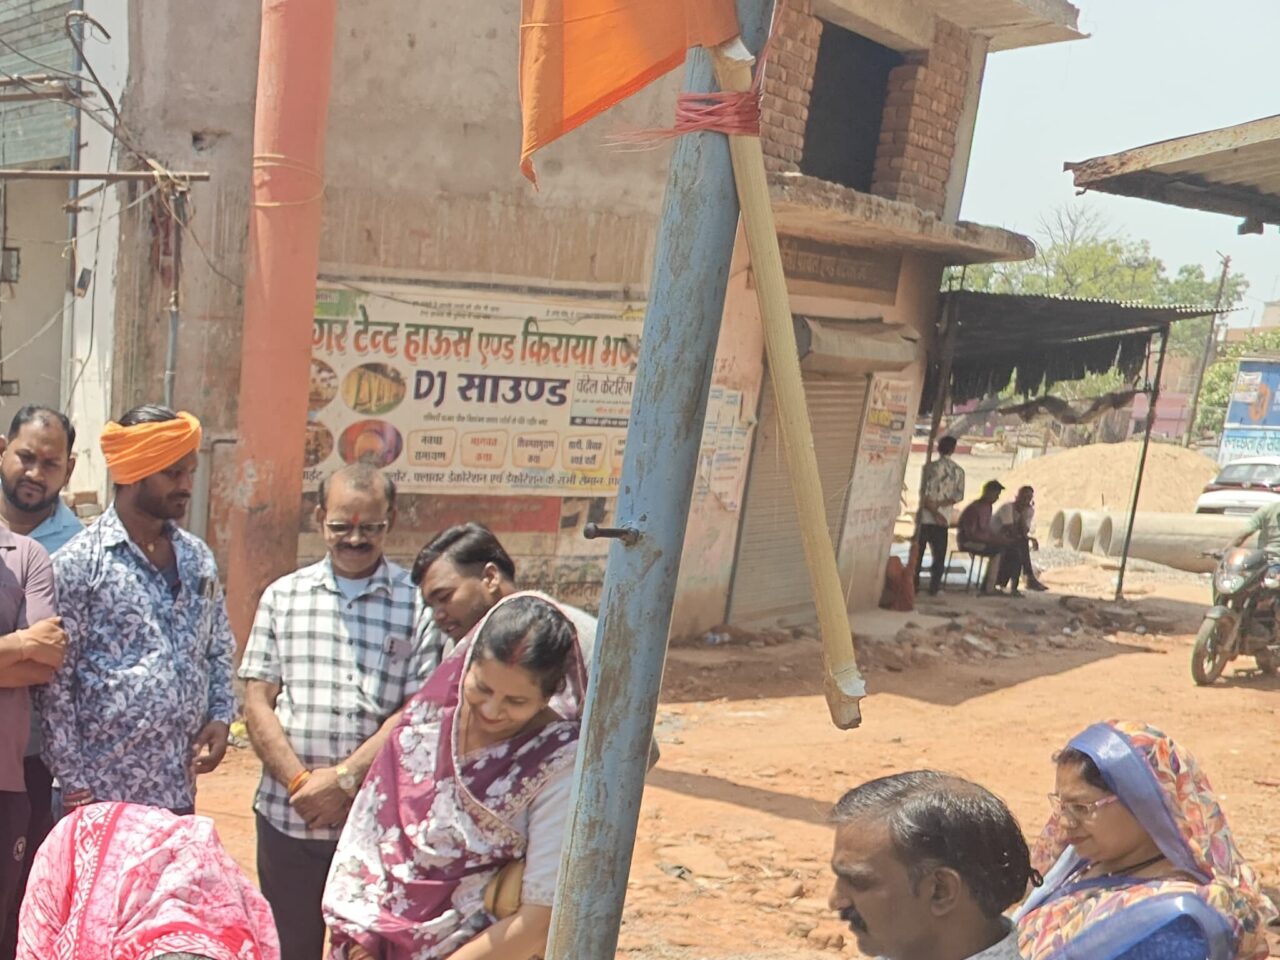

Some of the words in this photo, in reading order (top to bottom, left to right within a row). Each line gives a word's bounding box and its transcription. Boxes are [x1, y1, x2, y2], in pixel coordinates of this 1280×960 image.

[521, 316, 598, 365] किराया
[413, 370, 447, 408] DJ
[457, 373, 571, 406] साउण्ड
